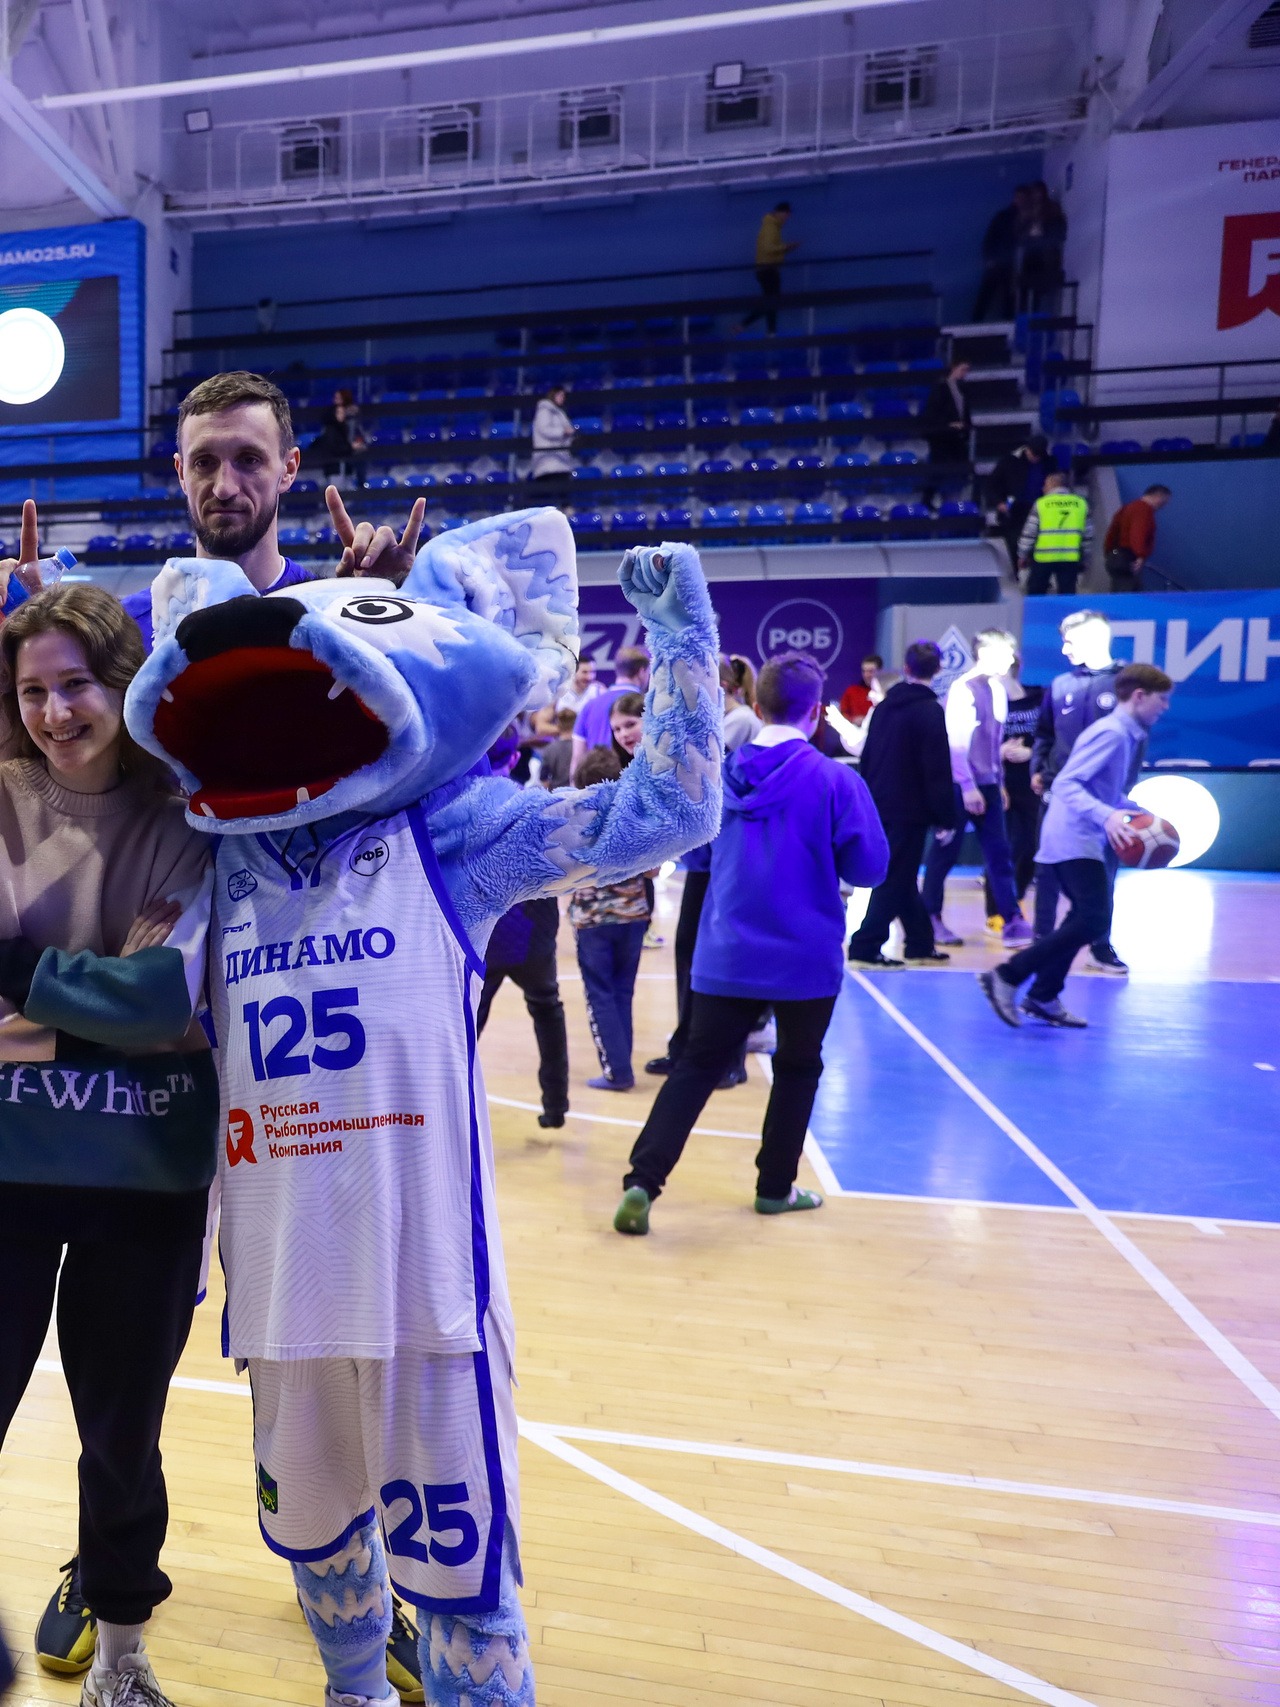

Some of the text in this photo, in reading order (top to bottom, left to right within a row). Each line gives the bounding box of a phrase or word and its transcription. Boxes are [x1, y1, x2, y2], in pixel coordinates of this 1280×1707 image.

[1218, 156, 1280, 171] ГЕНЕР
[768, 627, 833, 650] РФБ
[354, 847, 384, 866] РФБ
[225, 927, 396, 989] ДИНАМО
[243, 987, 366, 1082] 125
[259, 1101, 320, 1122] Русская
[264, 1112, 425, 1139] Рыбопромышленная
[268, 1140, 343, 1159] Компания
